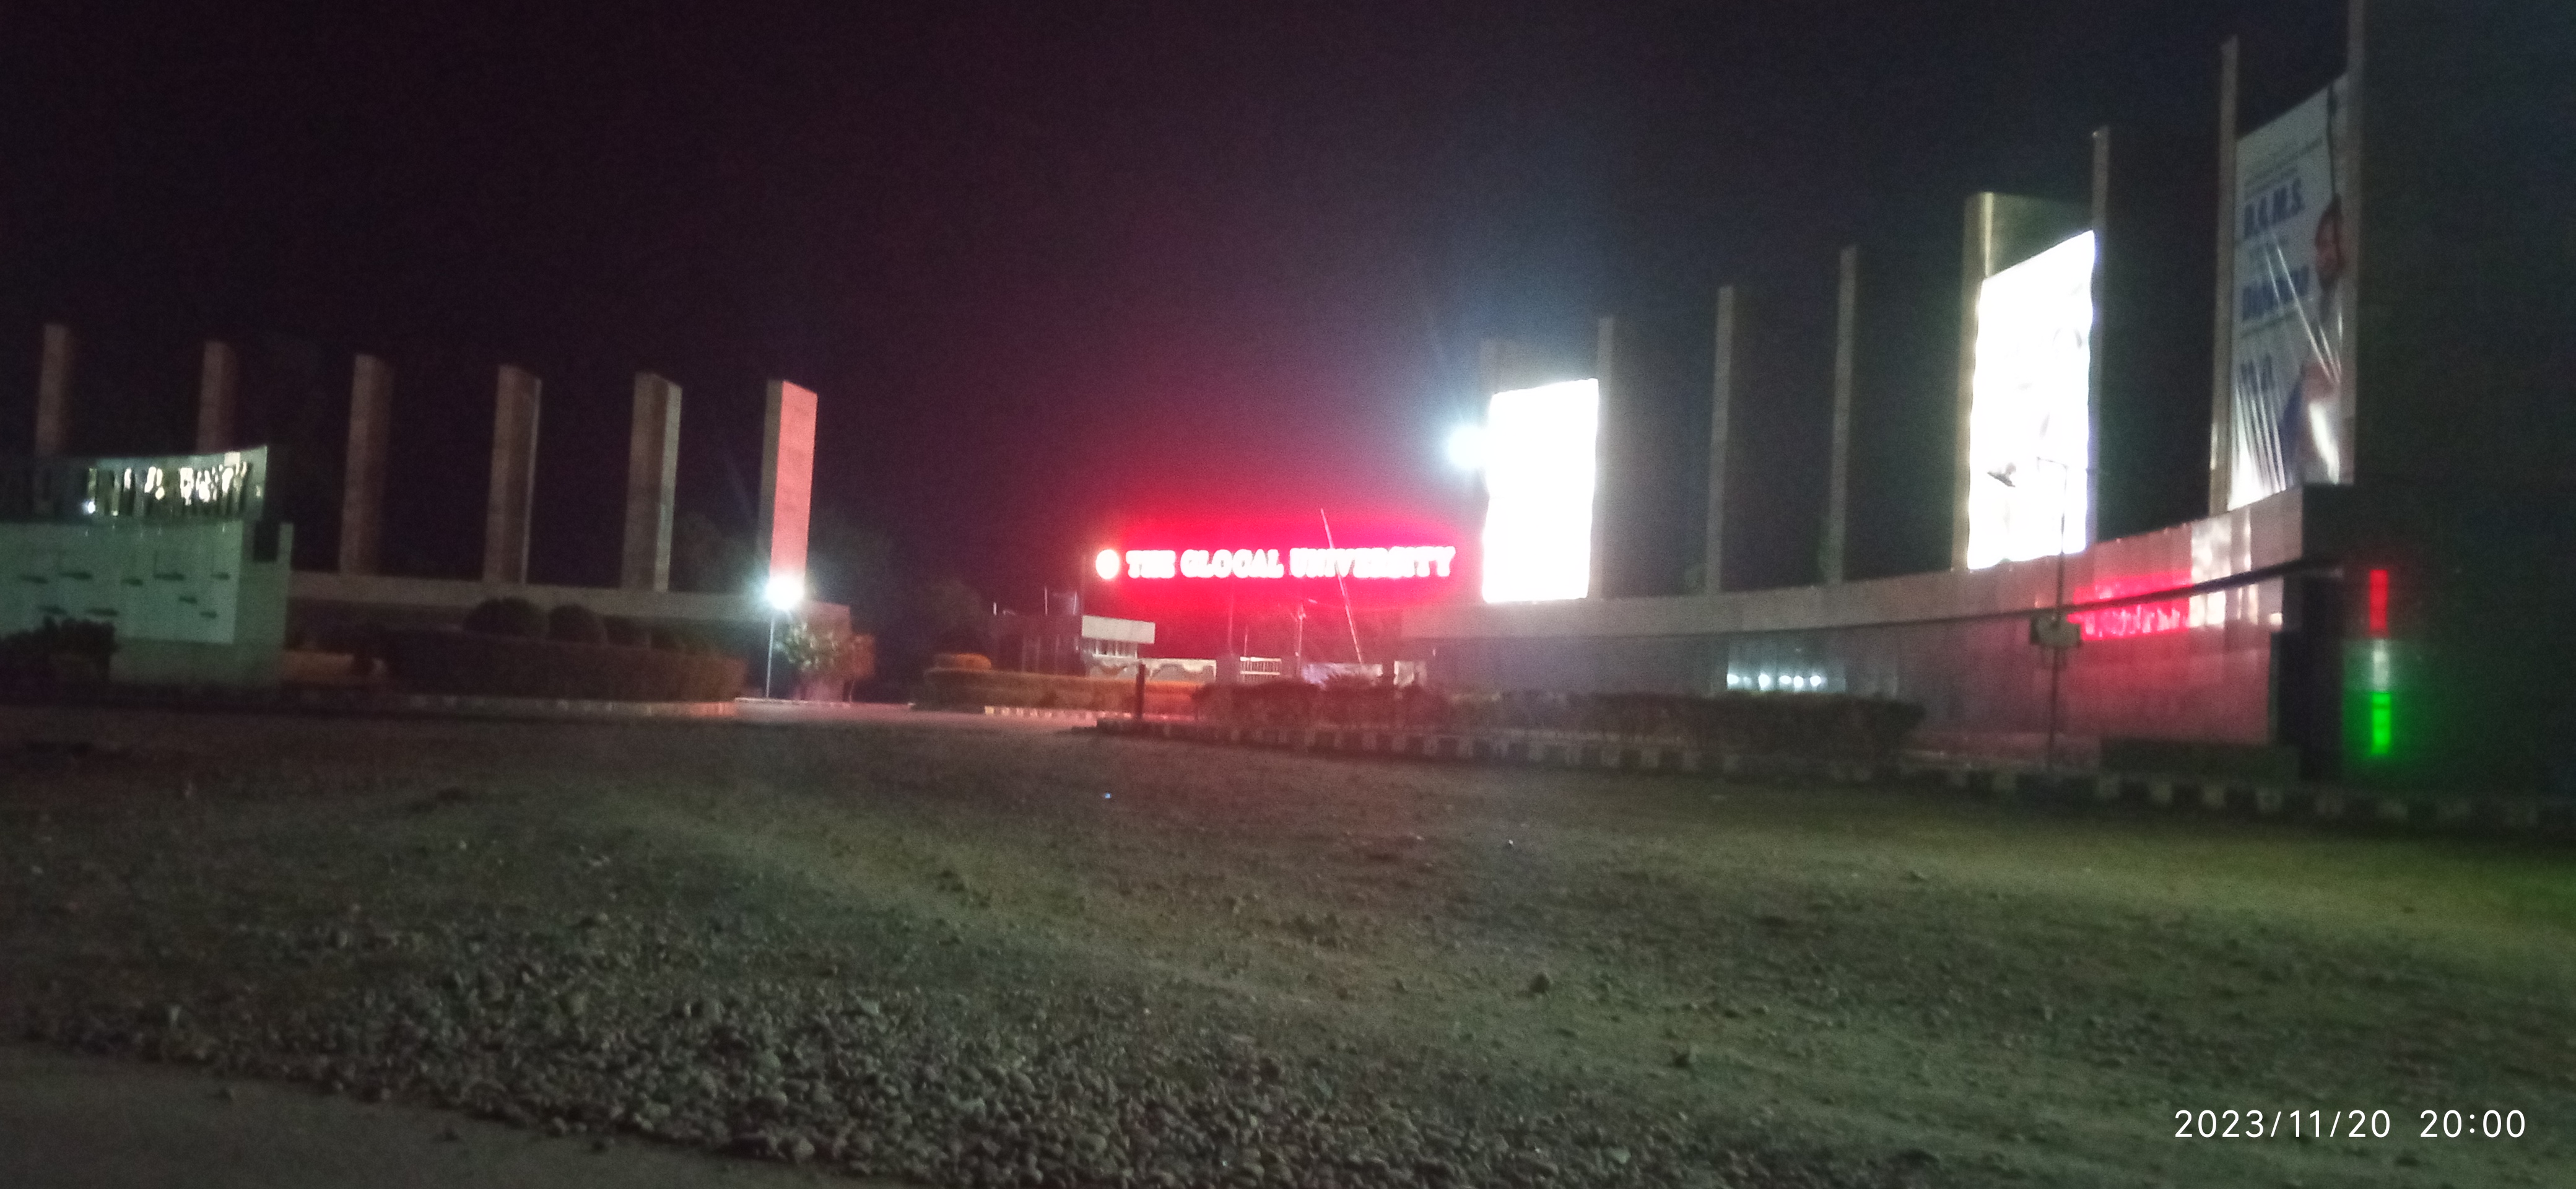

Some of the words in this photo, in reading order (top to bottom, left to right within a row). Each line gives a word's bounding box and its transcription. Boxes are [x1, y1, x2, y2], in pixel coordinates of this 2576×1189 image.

[1126, 549, 1176, 578] THE
[1180, 549, 1284, 578] GLOCAL
[1290, 546, 1456, 578] UNIVERSITY
